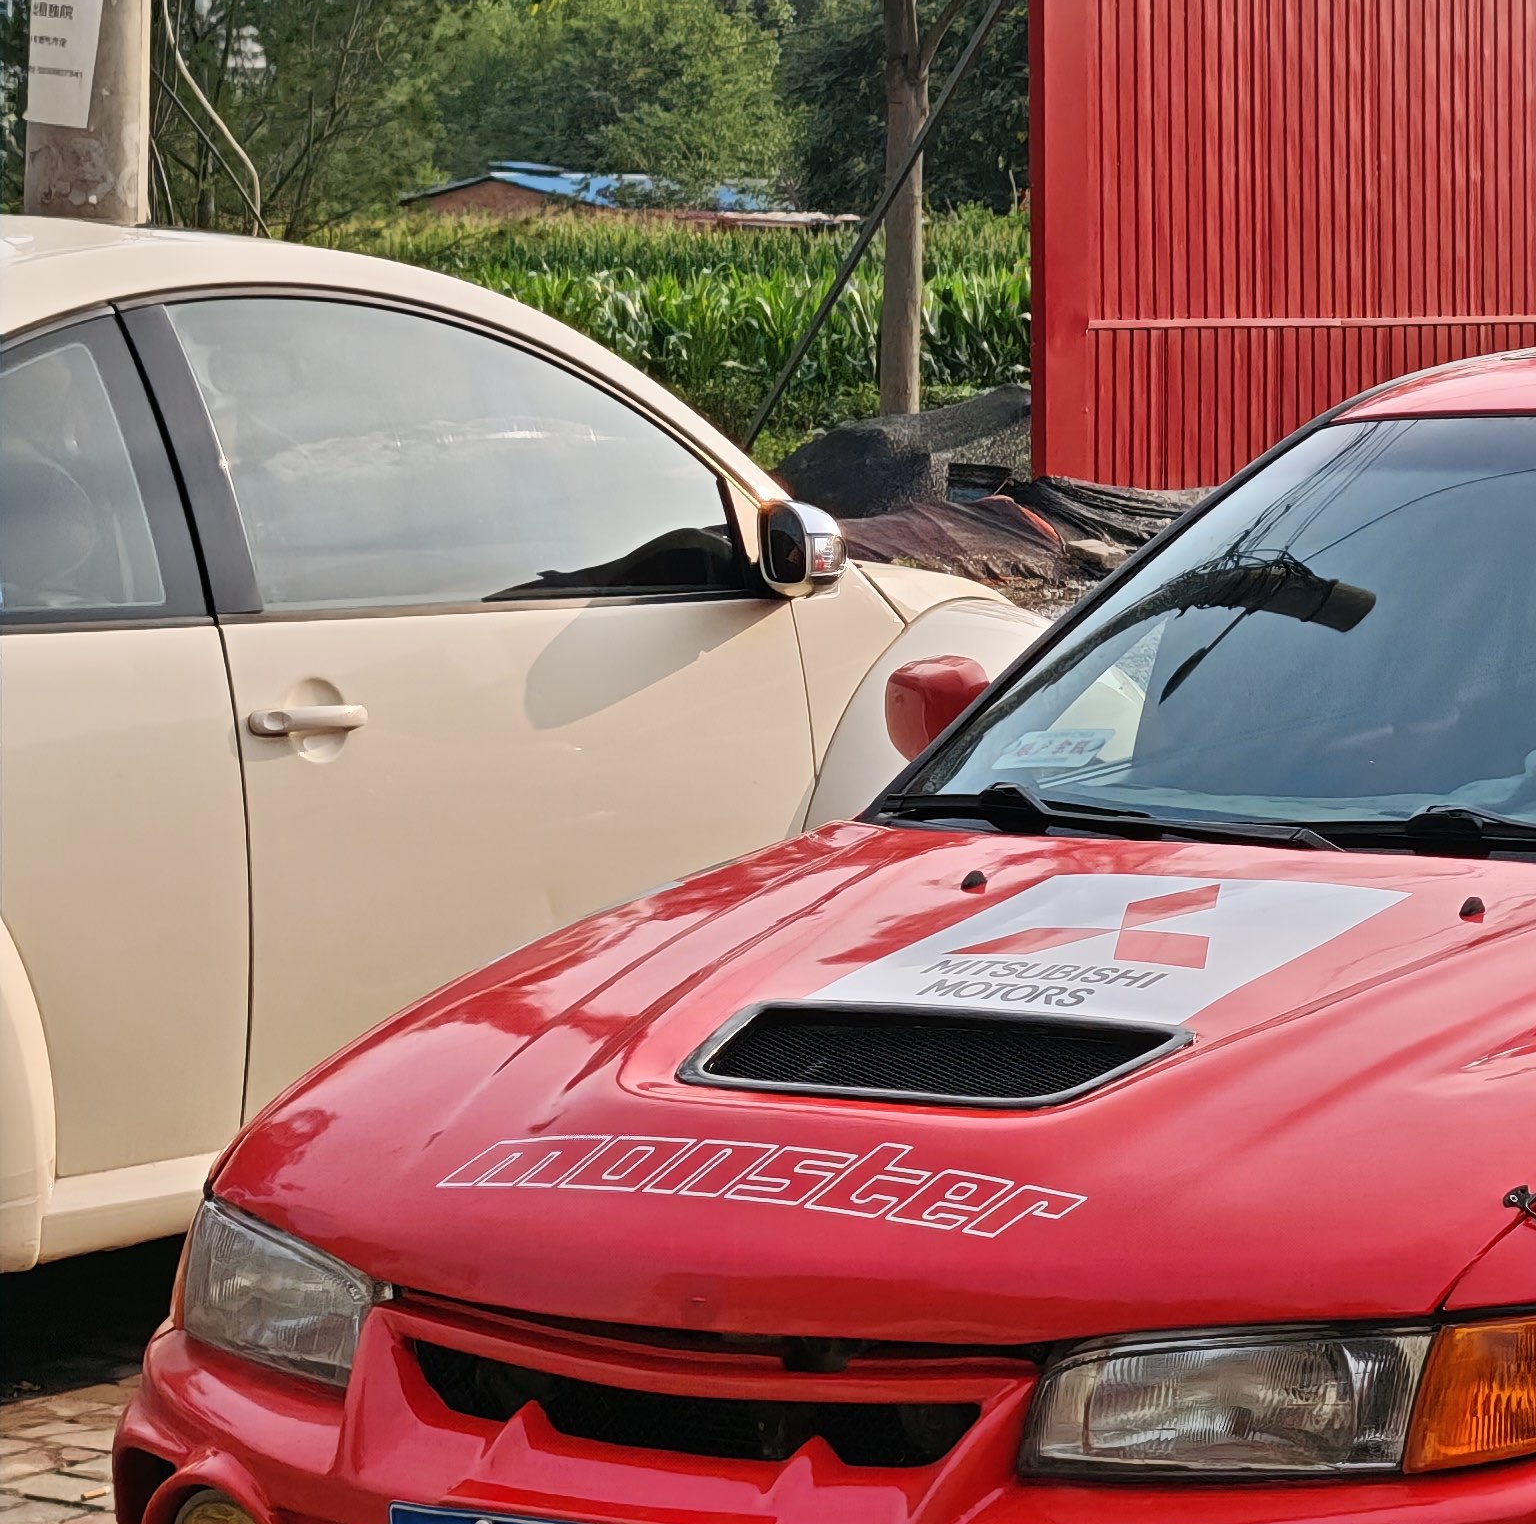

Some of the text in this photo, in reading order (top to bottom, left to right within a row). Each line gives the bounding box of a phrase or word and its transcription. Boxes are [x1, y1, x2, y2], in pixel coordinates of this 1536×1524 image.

[920, 959, 1168, 989] MITSUBISHI
[916, 978, 1095, 1007] MOTORS
[436, 1134, 1088, 1239] monster
